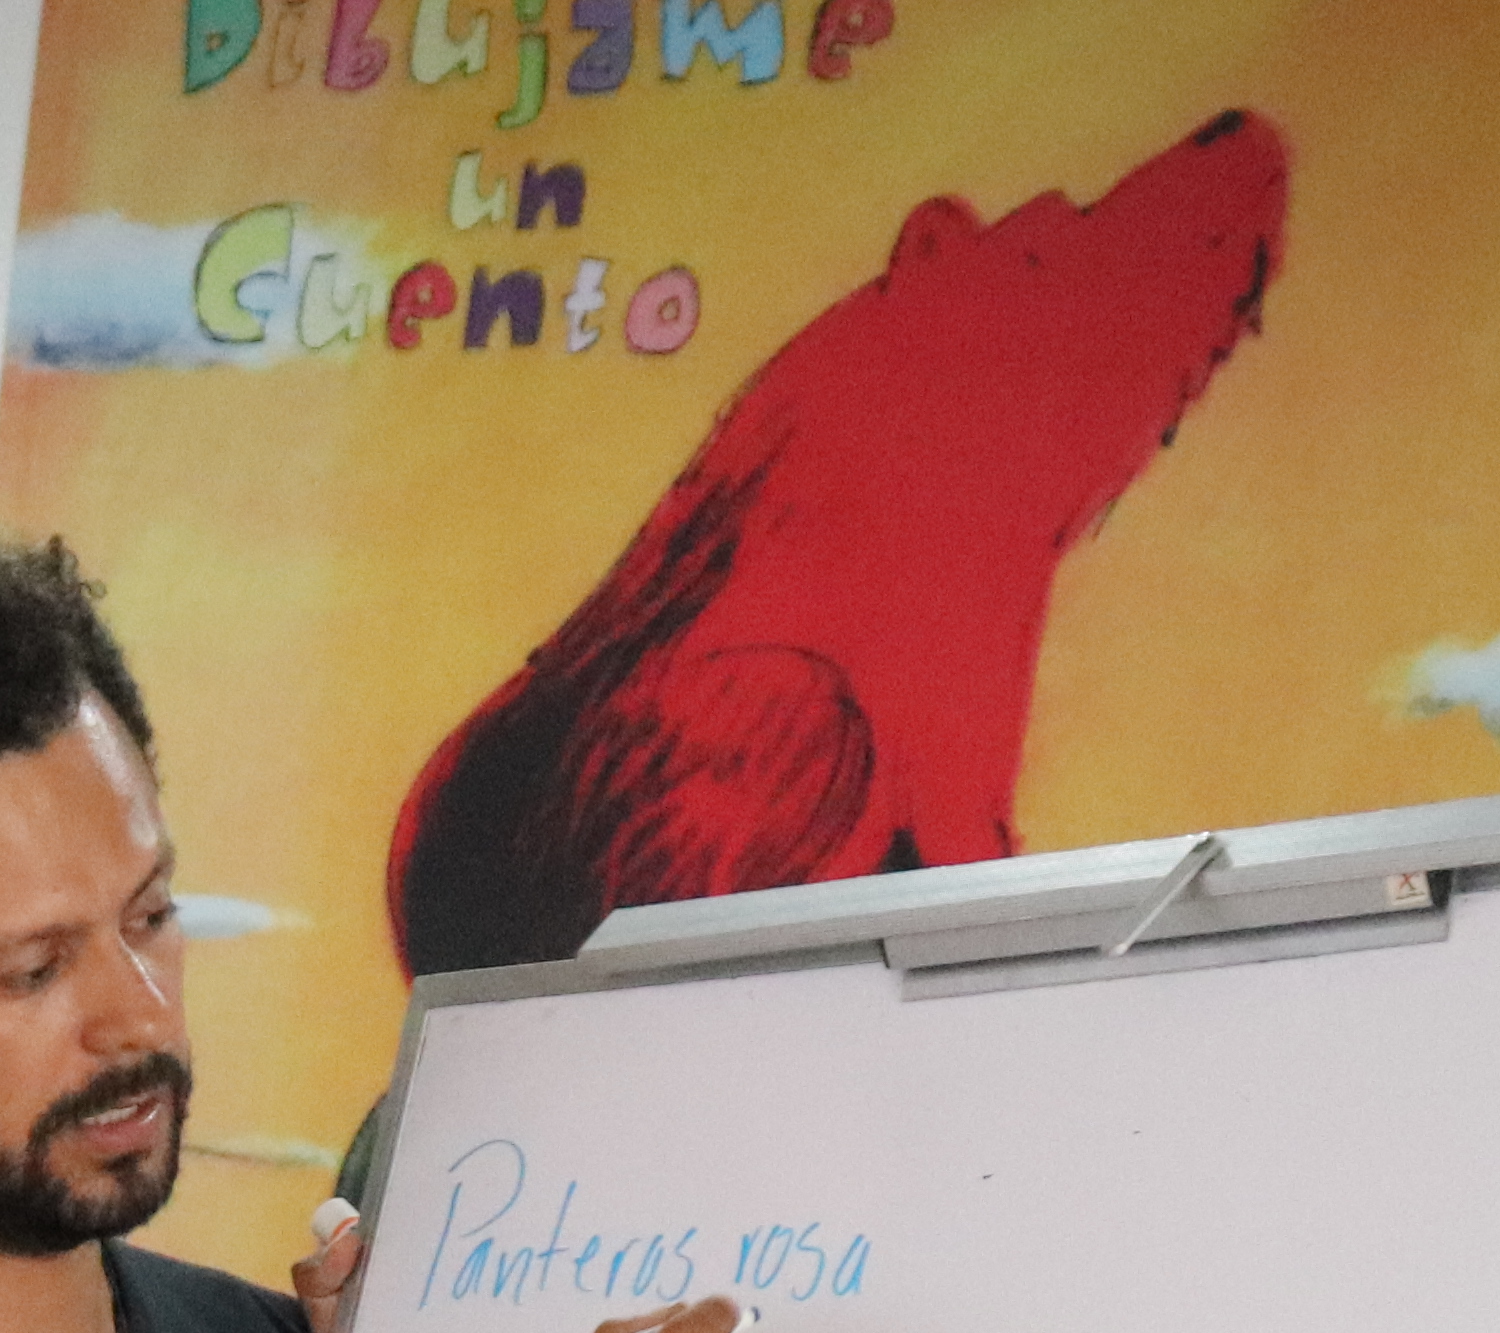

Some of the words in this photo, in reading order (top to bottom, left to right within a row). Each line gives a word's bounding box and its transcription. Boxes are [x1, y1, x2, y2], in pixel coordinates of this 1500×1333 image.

[449, 150, 587, 231] un
[194, 203, 700, 354] Cuento
[417, 1138, 698, 1310] Panteras
[734, 1221, 873, 1301] rosa
